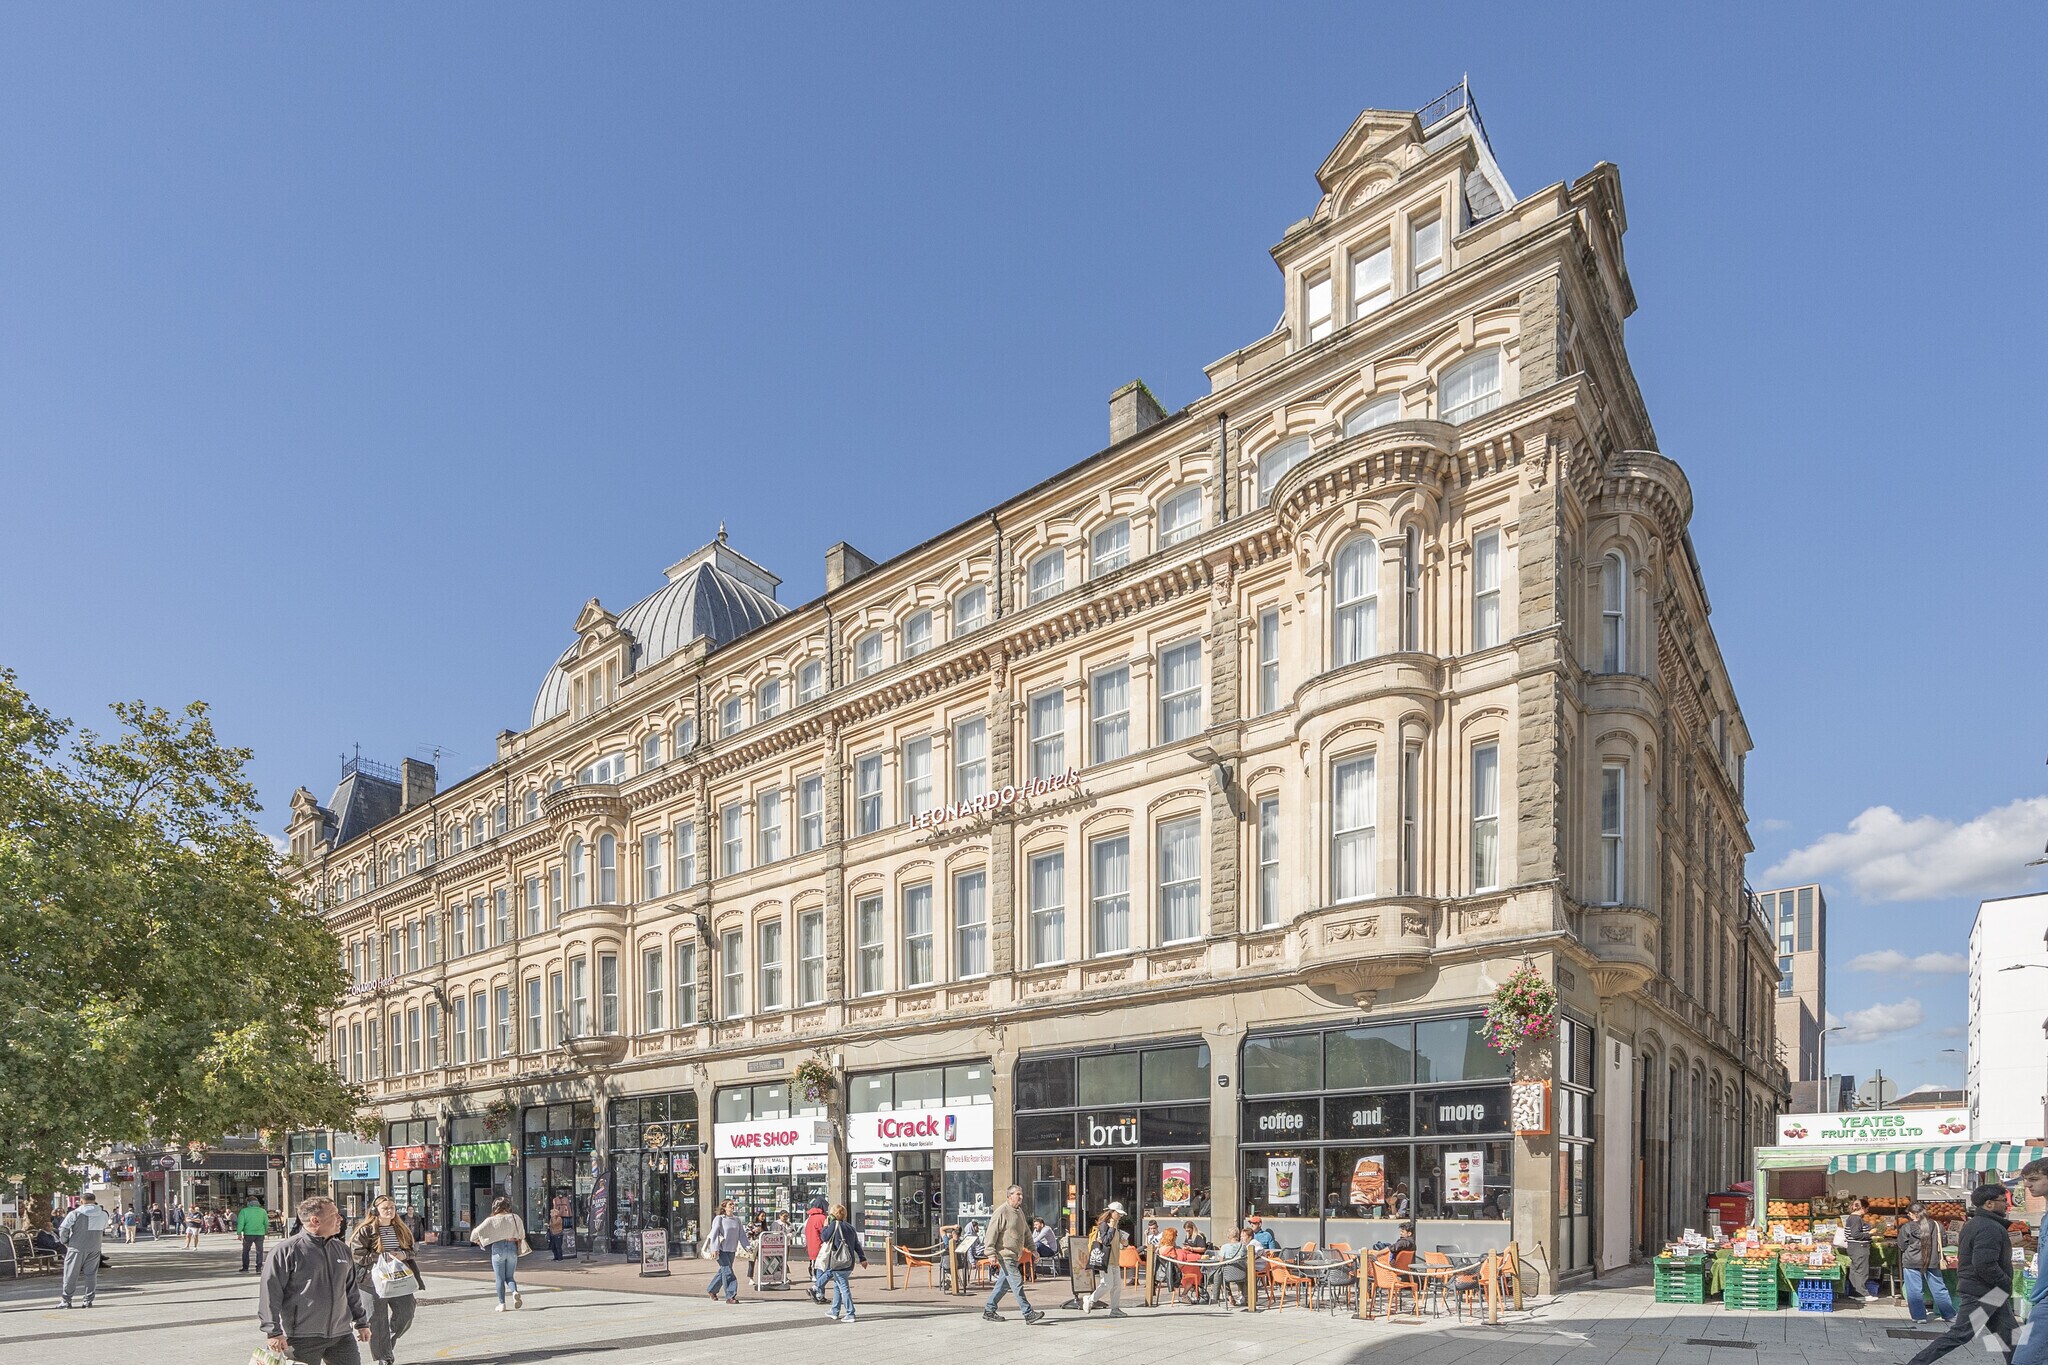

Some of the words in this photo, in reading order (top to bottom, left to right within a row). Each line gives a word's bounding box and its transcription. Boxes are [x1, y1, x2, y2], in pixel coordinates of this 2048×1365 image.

[909, 785, 1018, 831] LEONARDO
[1021, 766, 1082, 799] Hotels
[1259, 1112, 1304, 1130] coffee
[1352, 1107, 1382, 1126] and
[1439, 1103, 1485, 1122] more
[1838, 1115, 1906, 1128] YEATES
[877, 1114, 940, 1138] iCrack
[1087, 1115, 1139, 1146] brü
[1820, 1129, 1856, 1139] FRUIT
[1858, 1128, 1868, 1138] &
[1870, 1127, 1897, 1137] VEG
[1900, 1126, 1923, 1137] LTD
[730, 1133, 762, 1148] VAPE
[763, 1131, 799, 1147] SHOP
[319, 1152, 328, 1161] e
